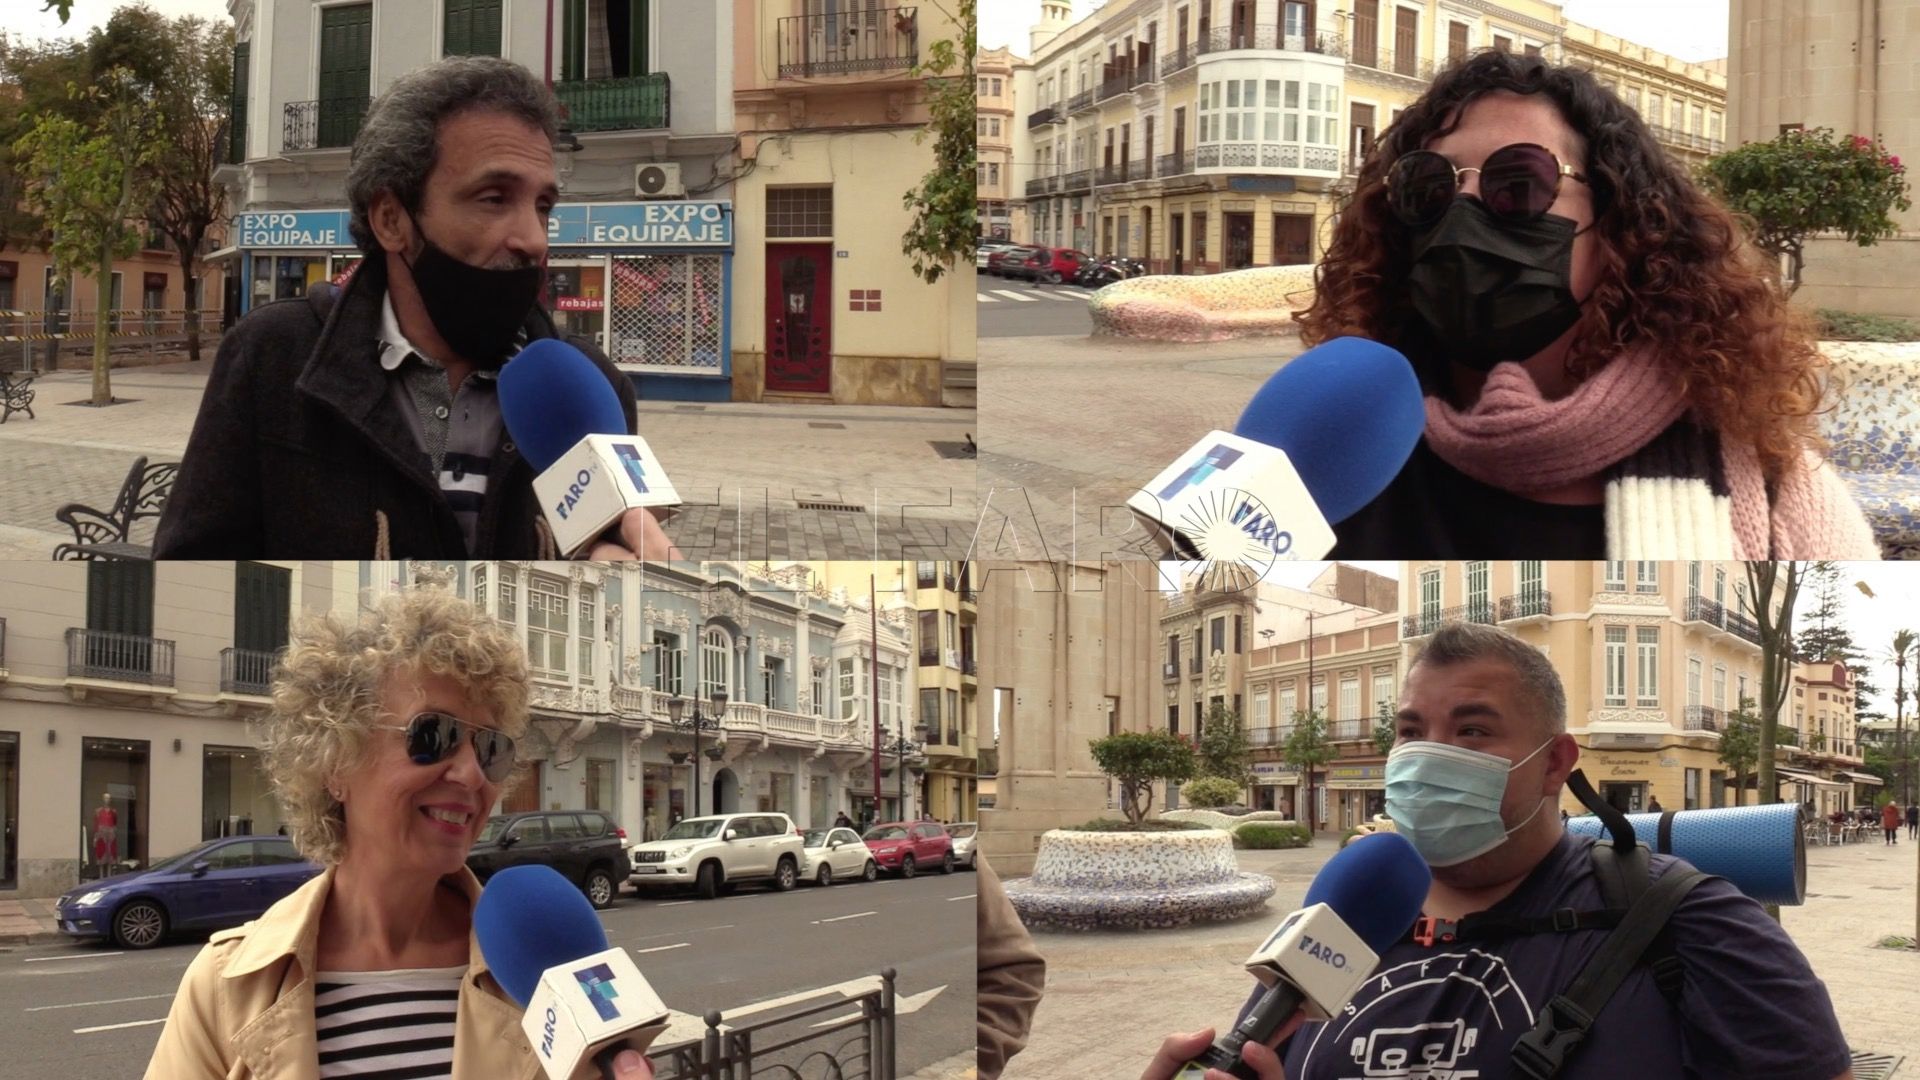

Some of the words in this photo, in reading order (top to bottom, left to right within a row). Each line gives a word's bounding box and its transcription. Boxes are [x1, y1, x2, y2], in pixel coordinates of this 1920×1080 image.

[243, 214, 297, 230] EXPO
[645, 204, 723, 223] EXPO
[243, 230, 336, 246] EQUIPAJE
[593, 224, 723, 242] EQUIPAJE
[560, 298, 604, 309] rebajas
[555, 469, 591, 520] FARO
[1298, 935, 1347, 969] FARO
[541, 1007, 557, 1060] FARO
